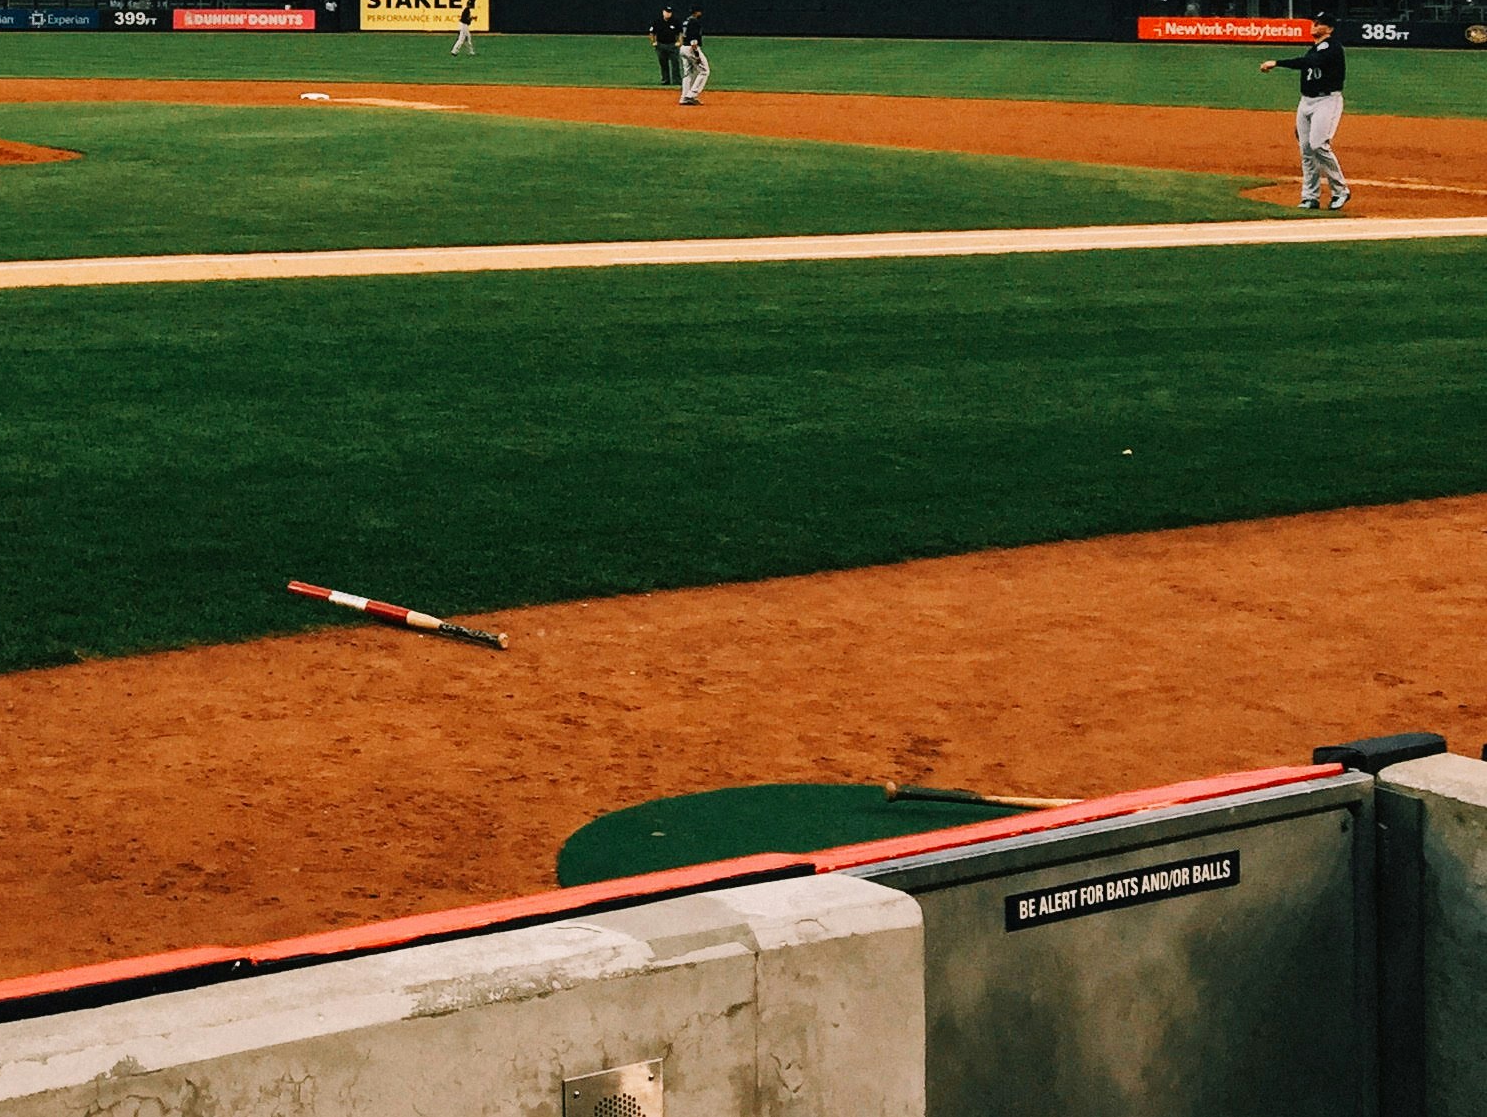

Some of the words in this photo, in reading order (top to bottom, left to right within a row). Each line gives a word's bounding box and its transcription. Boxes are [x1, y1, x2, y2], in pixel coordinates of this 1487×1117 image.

[47, 14, 89, 26] Experian
[194, 15, 248, 25] DUNKIN'
[249, 15, 303, 25] DONUTS
[1019, 899, 1035, 919] BE
[1039, 890, 1078, 915] ALERT
[1080, 885, 1104, 906] FOR
[1107, 877, 1139, 901] BATS
[1141, 868, 1190, 894] AND/OR
[1193, 860, 1231, 883] BALLS
